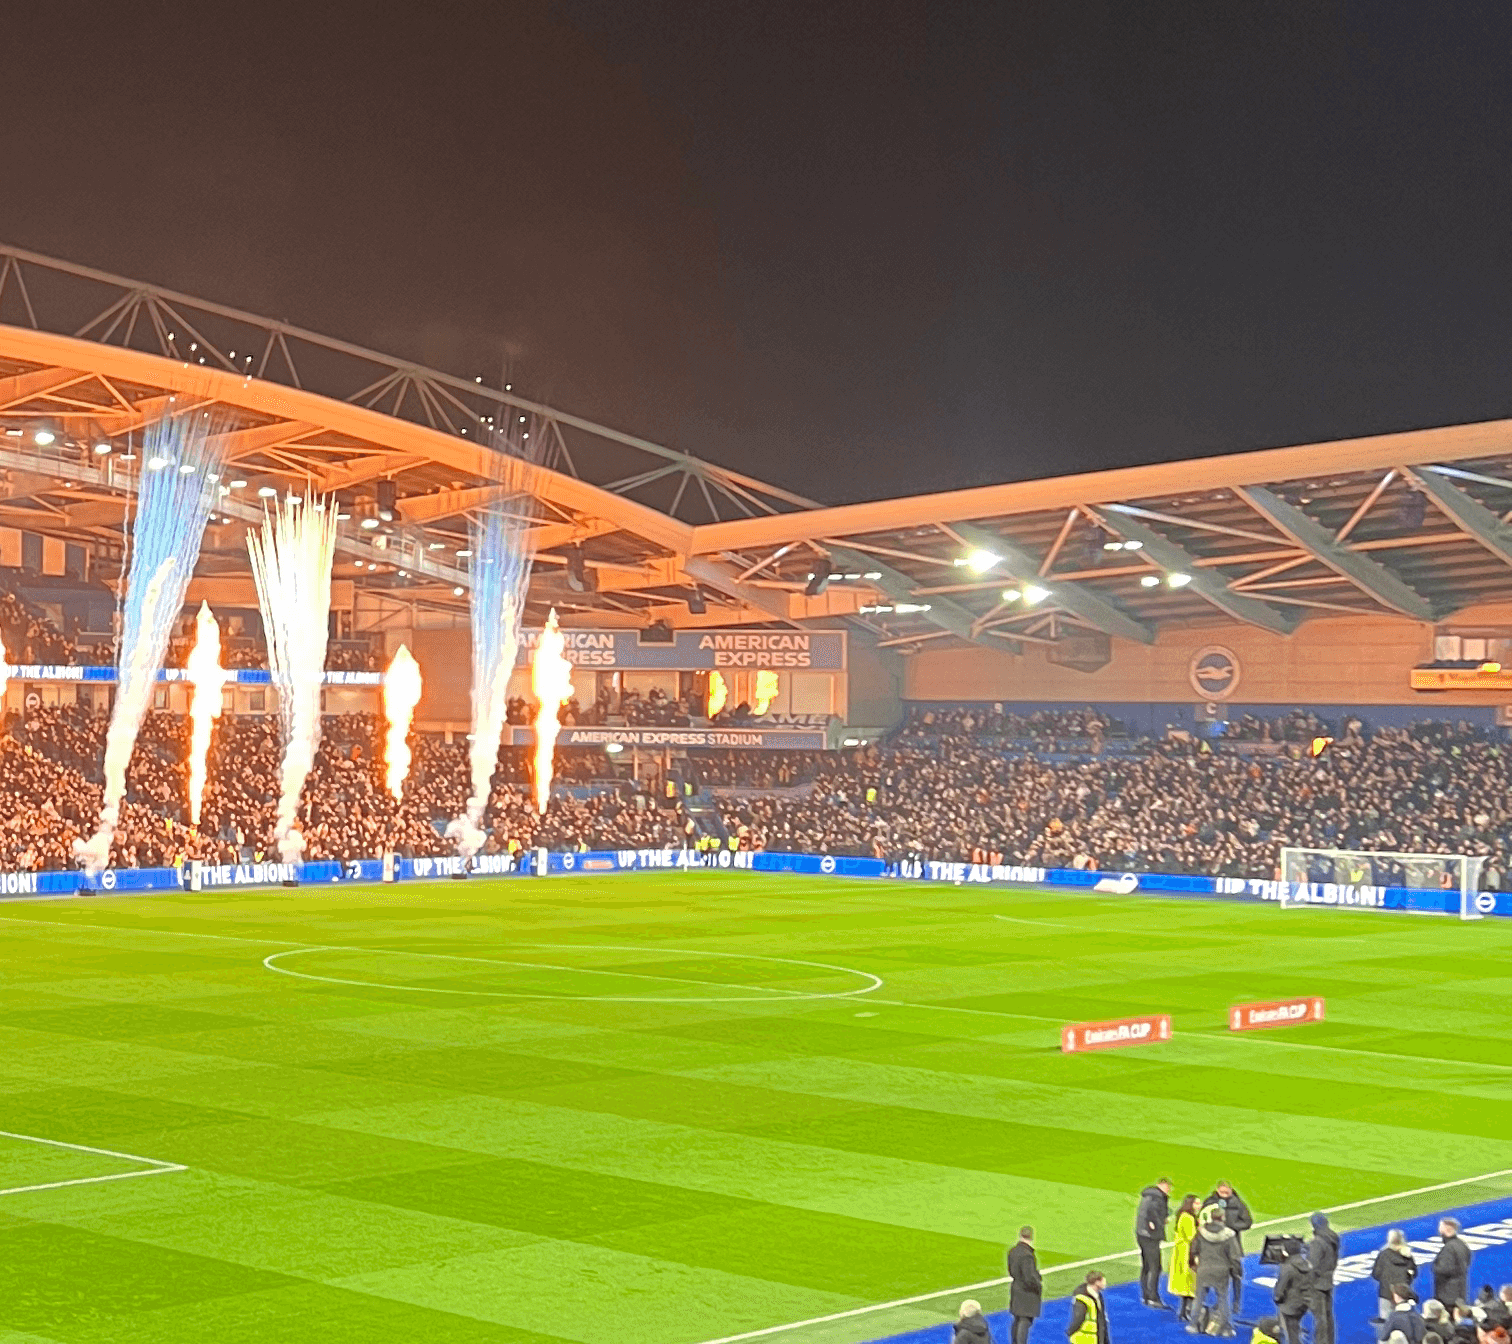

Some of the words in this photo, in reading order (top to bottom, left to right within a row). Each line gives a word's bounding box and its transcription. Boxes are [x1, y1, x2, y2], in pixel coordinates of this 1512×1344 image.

[698, 635, 809, 650] AMERICAN
[715, 651, 811, 666] EXPRESS
[571, 731, 640, 744] AMERICAN
[642, 732, 706, 745] EXPRESS
[707, 733, 763, 746] STADIUM
[413, 858, 433, 876] UP
[434, 856, 462, 874] THE
[618, 850, 637, 867] UP
[638, 849, 673, 867] THE
[201, 865, 231, 885] THE
[235, 863, 294, 883] ALBION!
[929, 860, 965, 879] THE
[1249, 879, 1290, 901] THE
[1294, 882, 1386, 907] ALBION!
